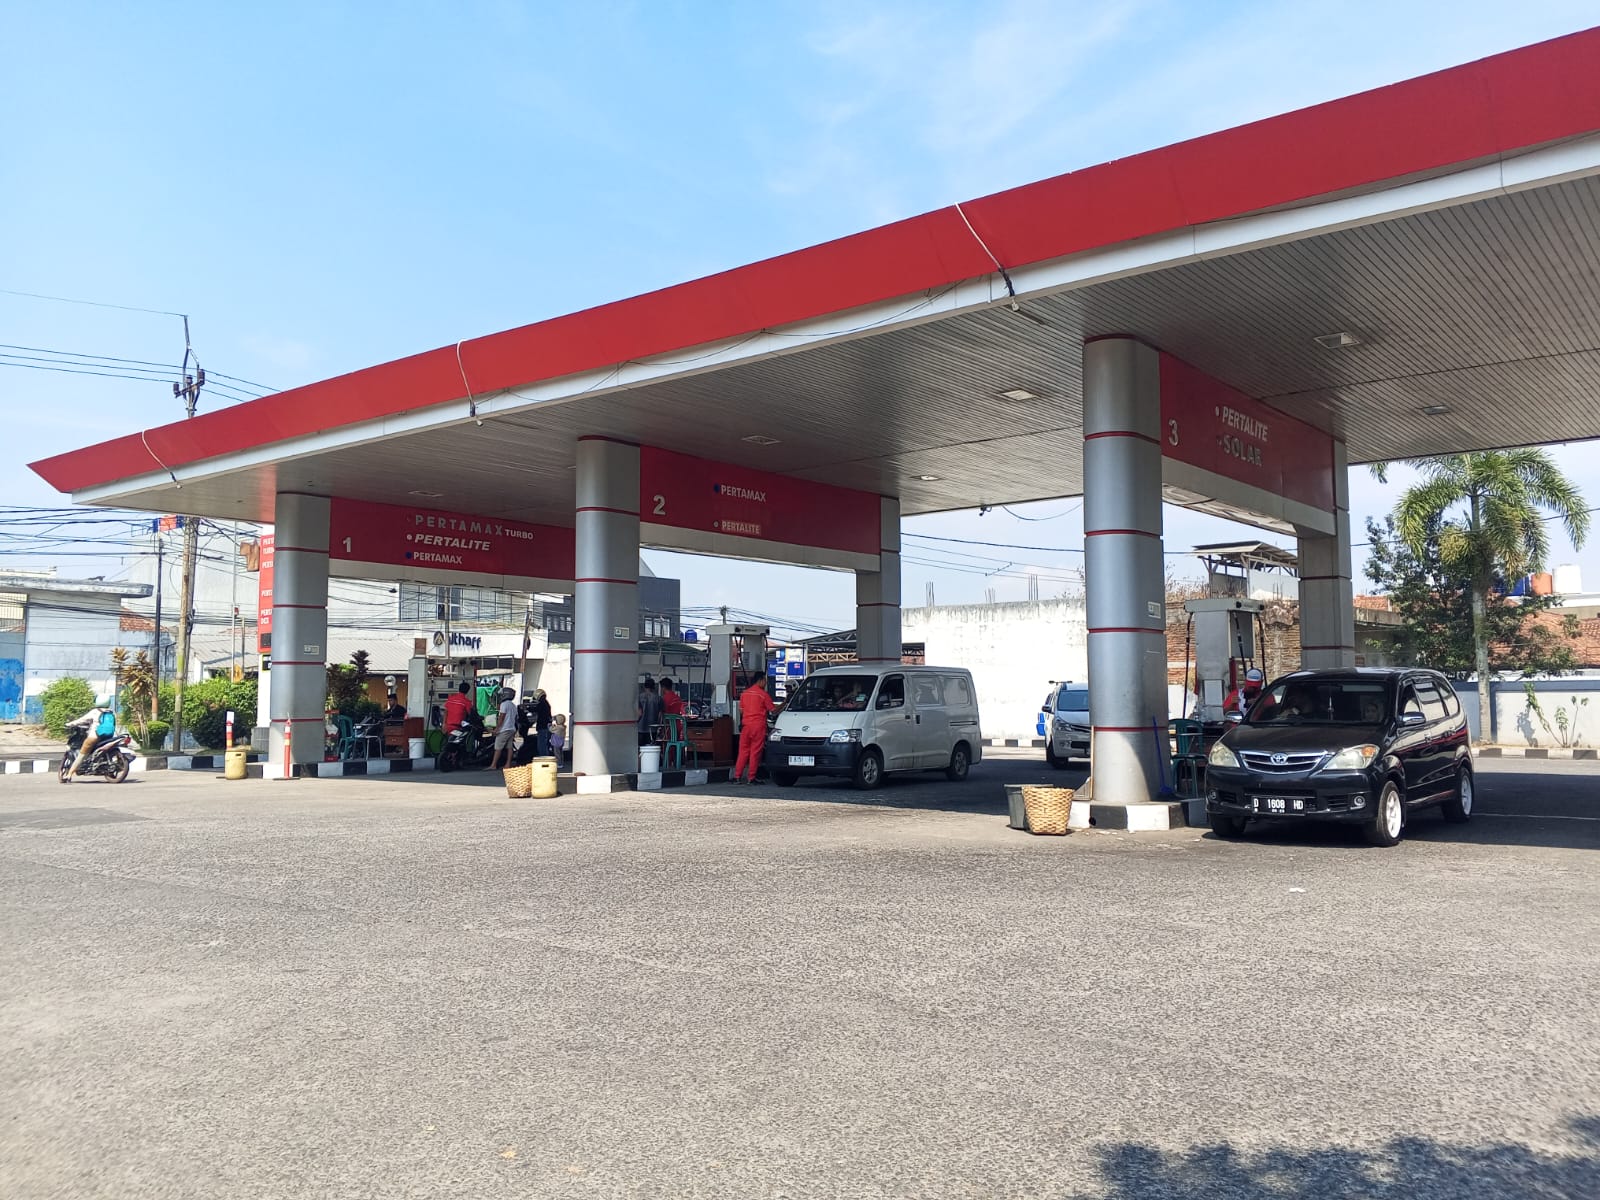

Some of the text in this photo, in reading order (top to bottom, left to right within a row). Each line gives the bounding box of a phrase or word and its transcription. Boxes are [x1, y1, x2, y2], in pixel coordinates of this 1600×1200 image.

[1168, 419, 1179, 446] 3
[1222, 406, 1269, 442] PERTALITE
[1222, 435, 1262, 467] SOLAR
[721, 484, 766, 502] PERTAMAX
[653, 494, 666, 515] 2
[415, 515, 534, 540] PERTAMAX TURBO
[721, 520, 761, 535] PERTALITE
[342, 537, 352, 553] 1
[414, 533, 491, 551] PERTALITE
[413, 552, 463, 565] PERTAMAX
[1253, 798, 1259, 808] D
